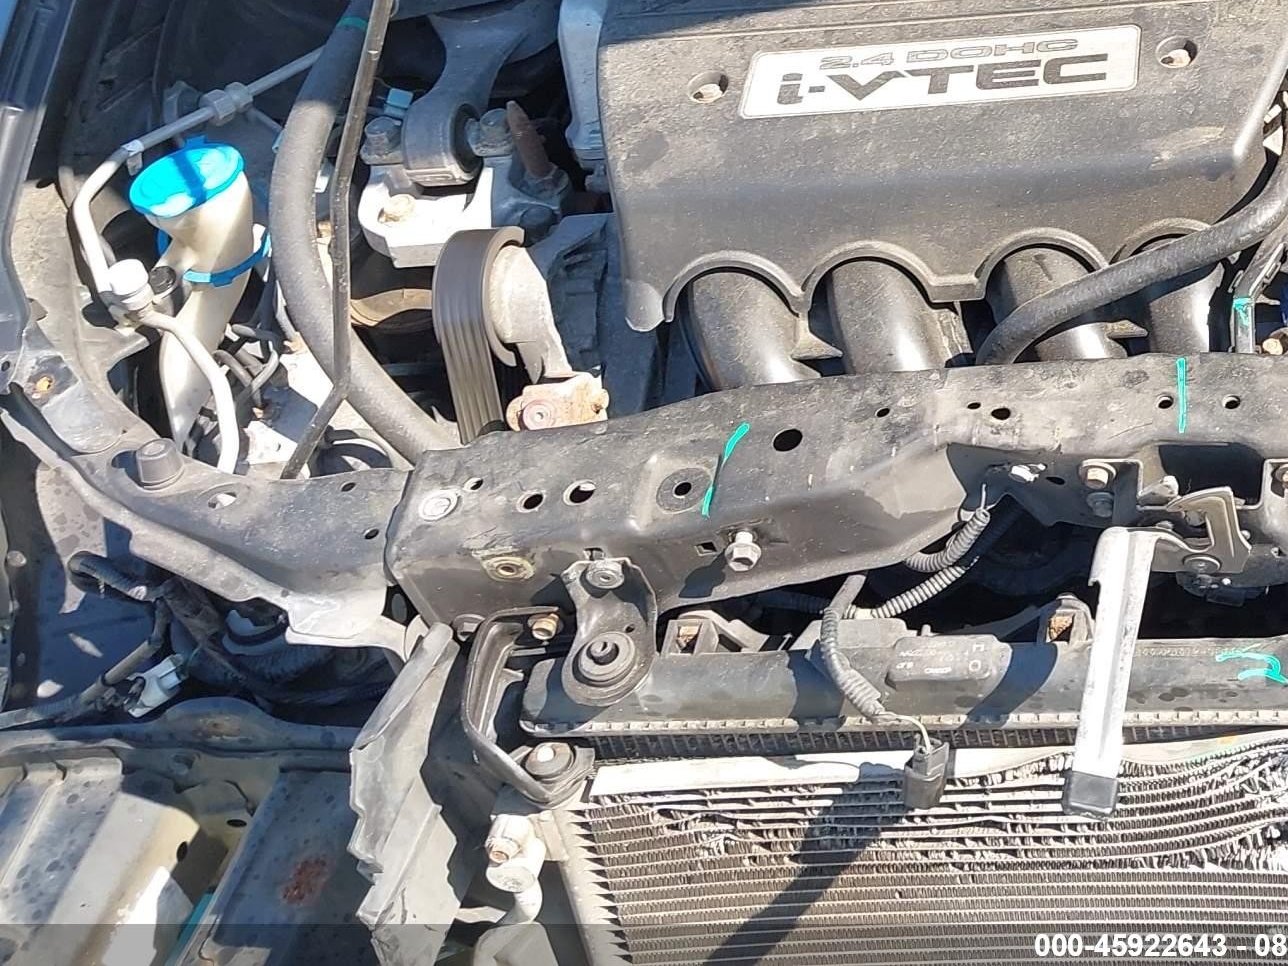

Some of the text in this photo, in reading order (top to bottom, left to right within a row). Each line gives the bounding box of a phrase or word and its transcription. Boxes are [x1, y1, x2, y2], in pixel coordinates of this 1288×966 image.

[819, 38, 1079, 70] 2.4 DOHC
[776, 52, 1109, 106] i-VTEC
